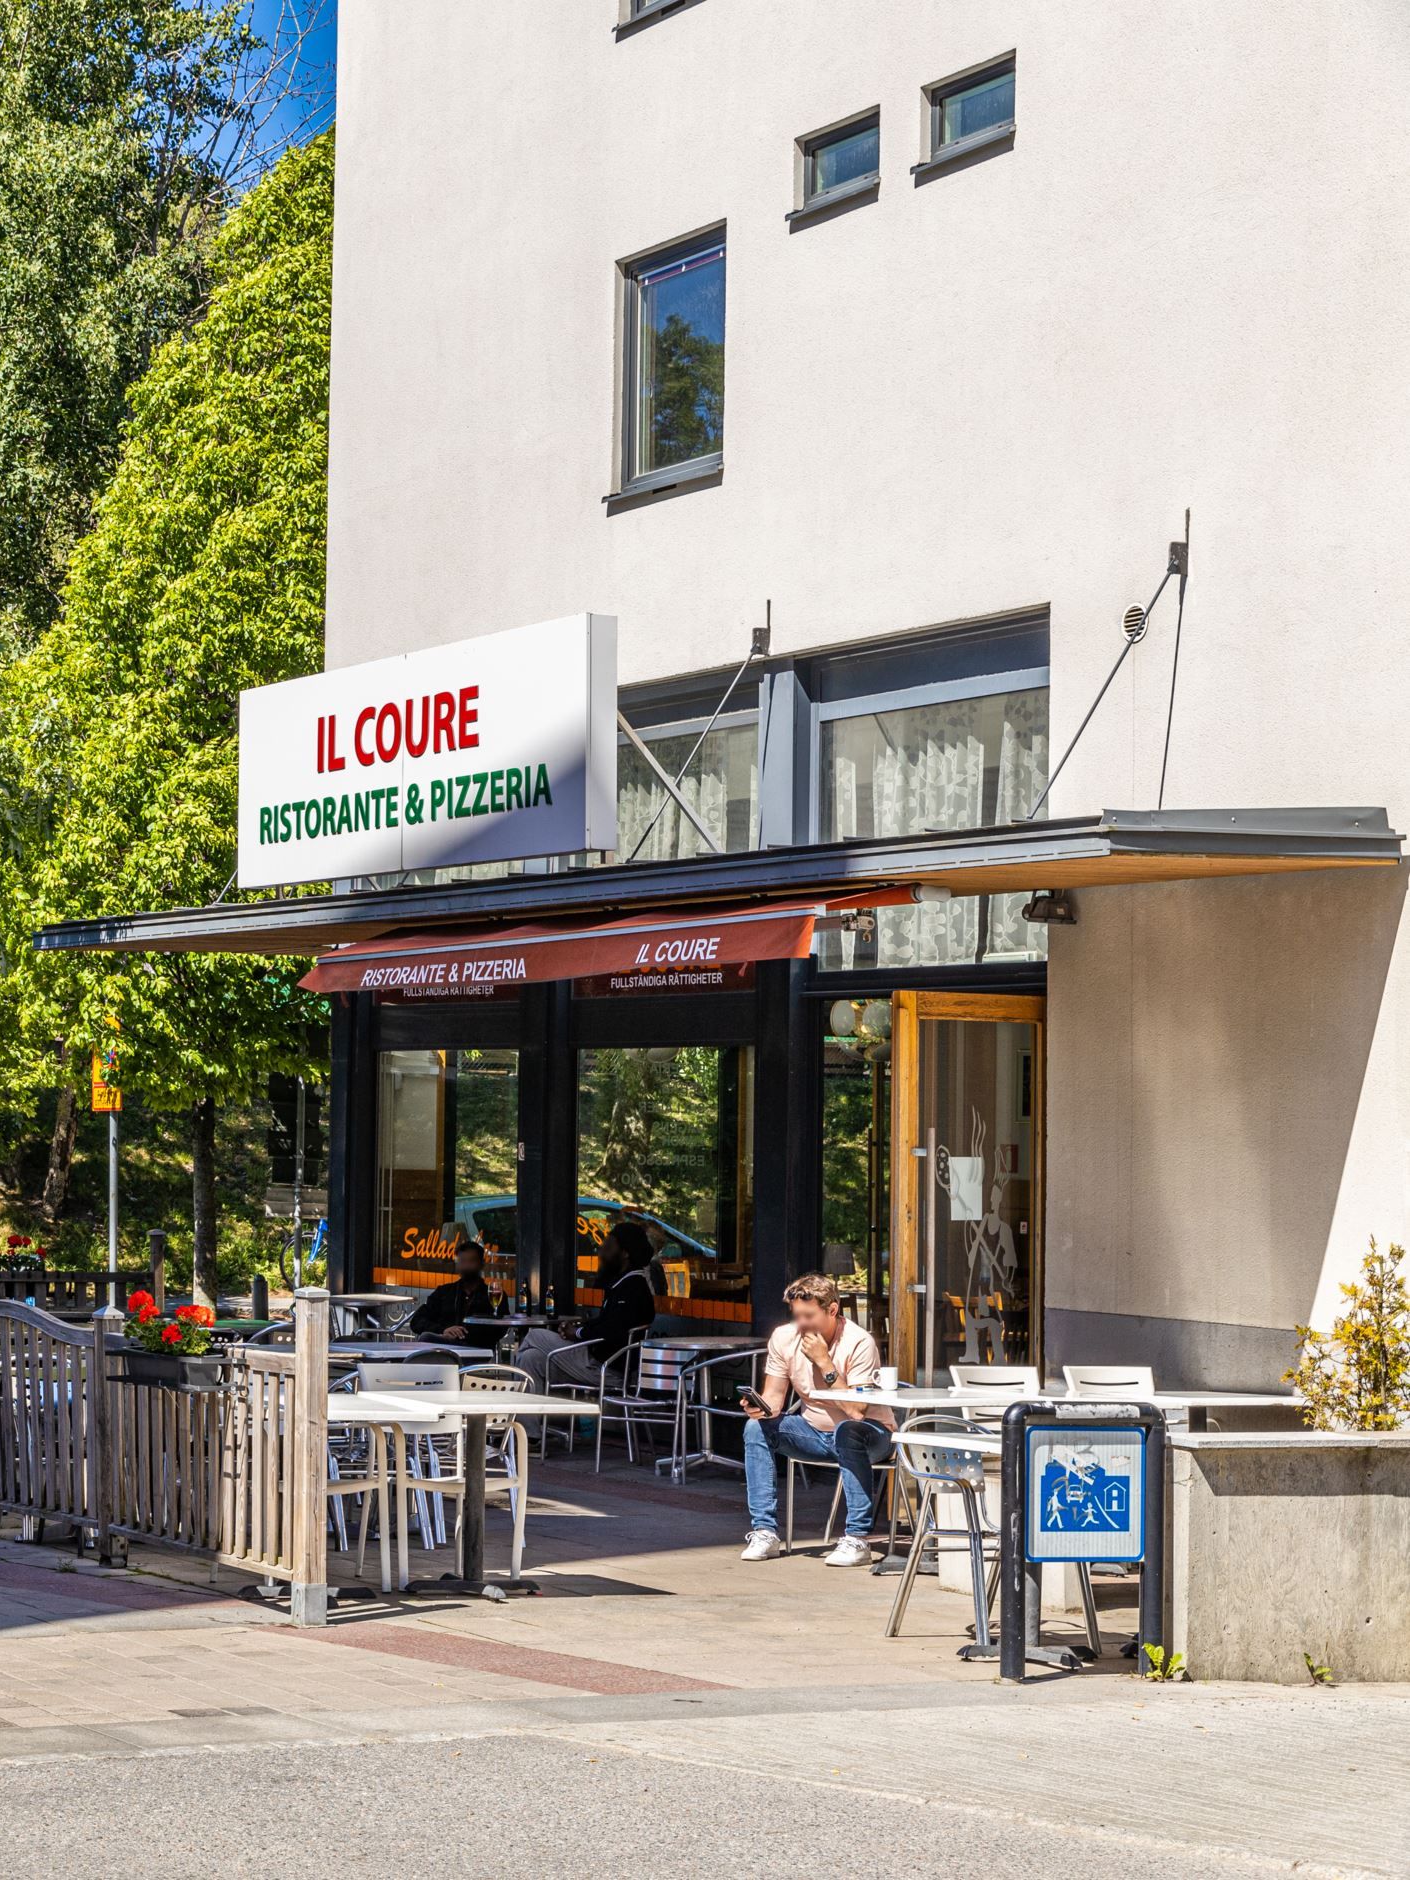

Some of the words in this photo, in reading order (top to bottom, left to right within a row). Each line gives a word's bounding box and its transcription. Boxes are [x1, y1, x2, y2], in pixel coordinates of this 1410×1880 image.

[317, 714, 346, 773] IL
[354, 685, 480, 767] COURE
[259, 786, 399, 845] RISTORANTE
[405, 782, 424, 826] &
[431, 763, 553, 821] PIZZERIA
[635, 943, 649, 964] IL
[654, 937, 721, 962] COURE
[360, 963, 447, 988] RISTORANTE
[448, 964, 459, 983] &
[462, 957, 527, 982] PIZZERIA
[610, 974, 667, 989] FULLSTÄNDIGA
[668, 972, 723, 986] RÄTTIGHETER
